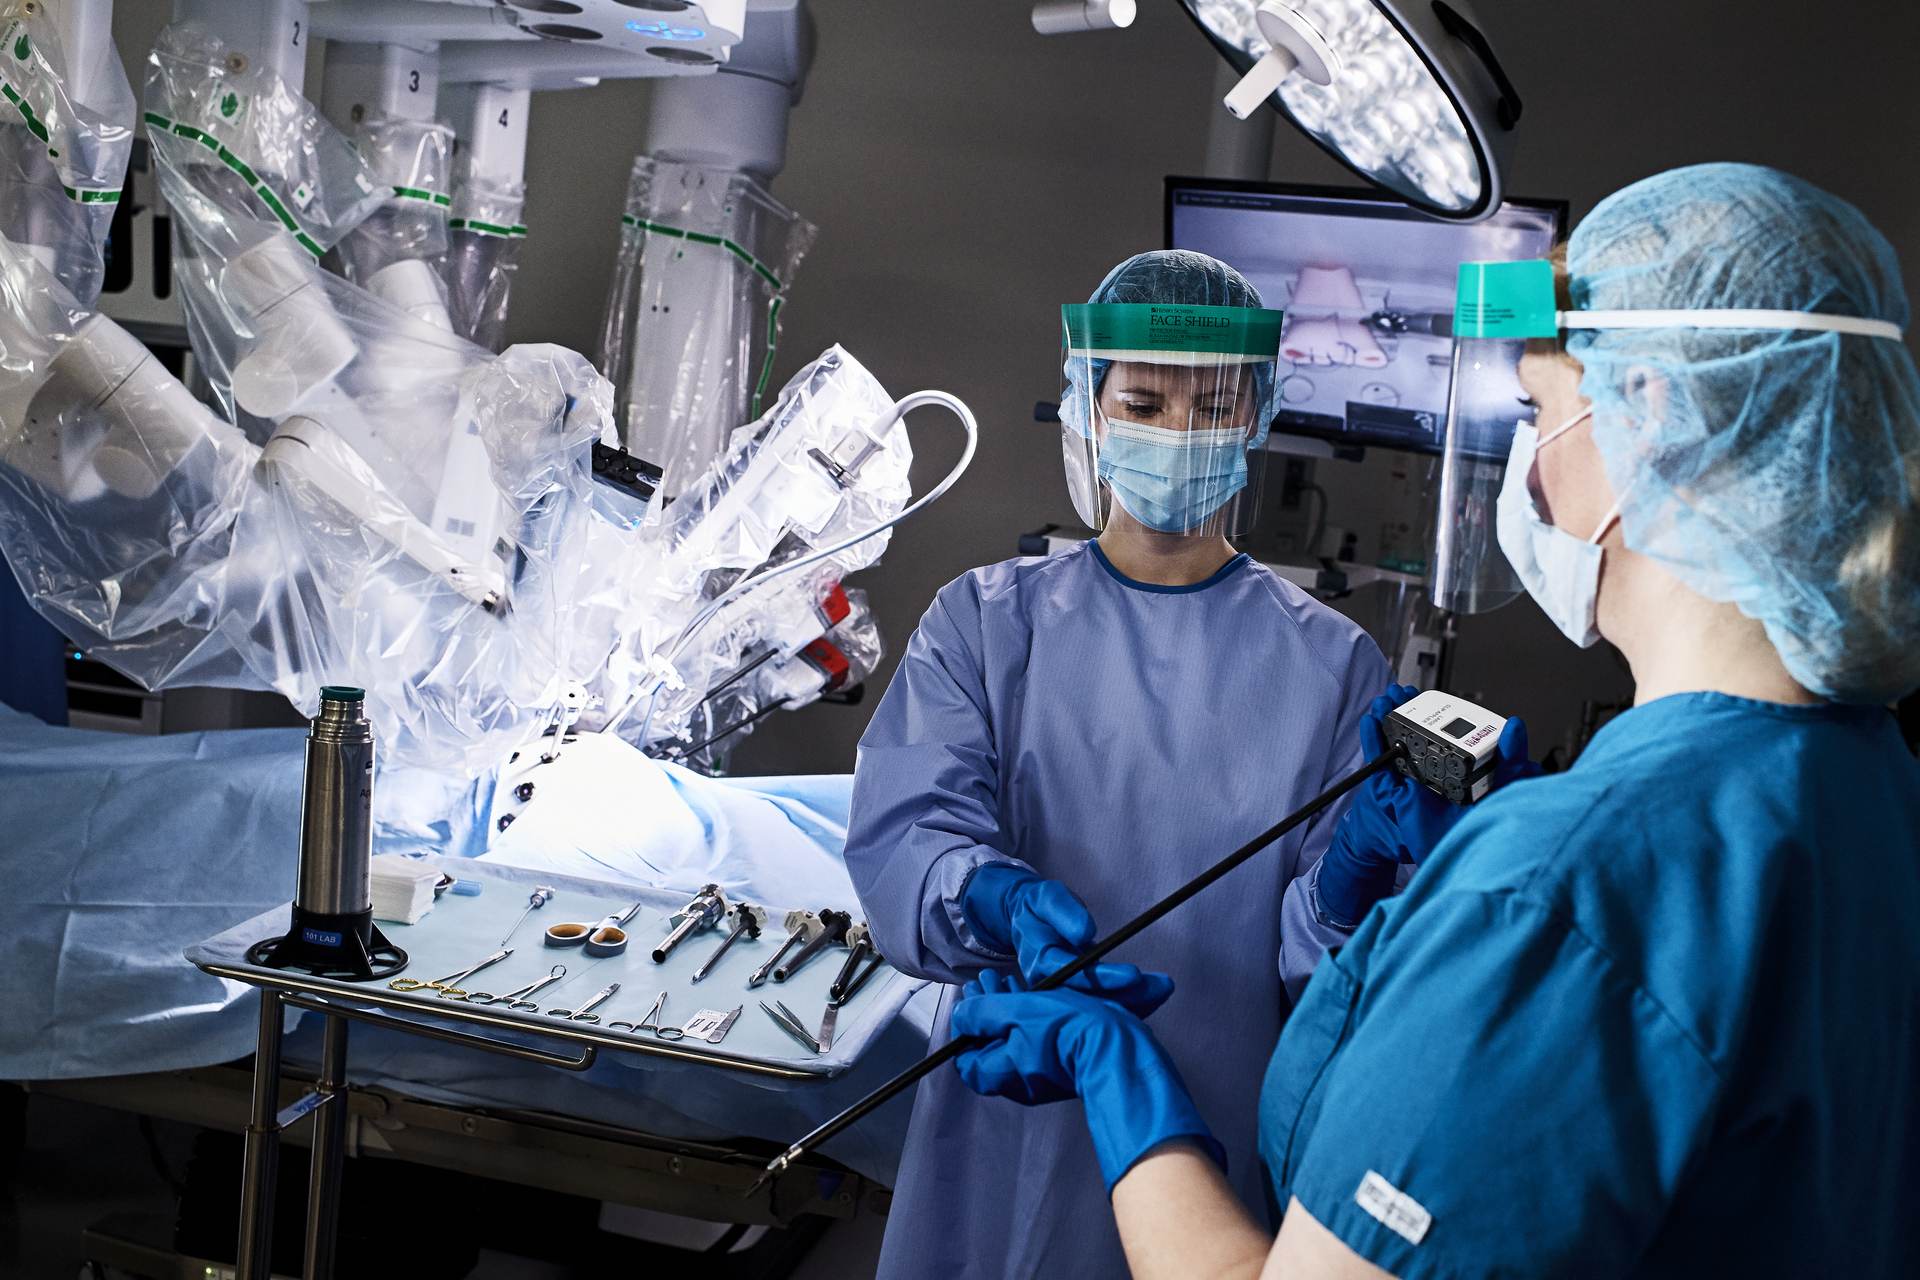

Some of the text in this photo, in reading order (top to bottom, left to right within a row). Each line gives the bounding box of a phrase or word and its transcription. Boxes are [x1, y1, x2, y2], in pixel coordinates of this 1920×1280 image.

[292, 20, 300, 46] 2
[408, 70, 420, 93] 3
[498, 108, 509, 127] 4
[1150, 314, 1230, 328] FACE SHIELD
[1440, 703, 1452, 713] CLIP
[1427, 715, 1444, 727] LARGE
[305, 931, 337, 943] 101 LAB
